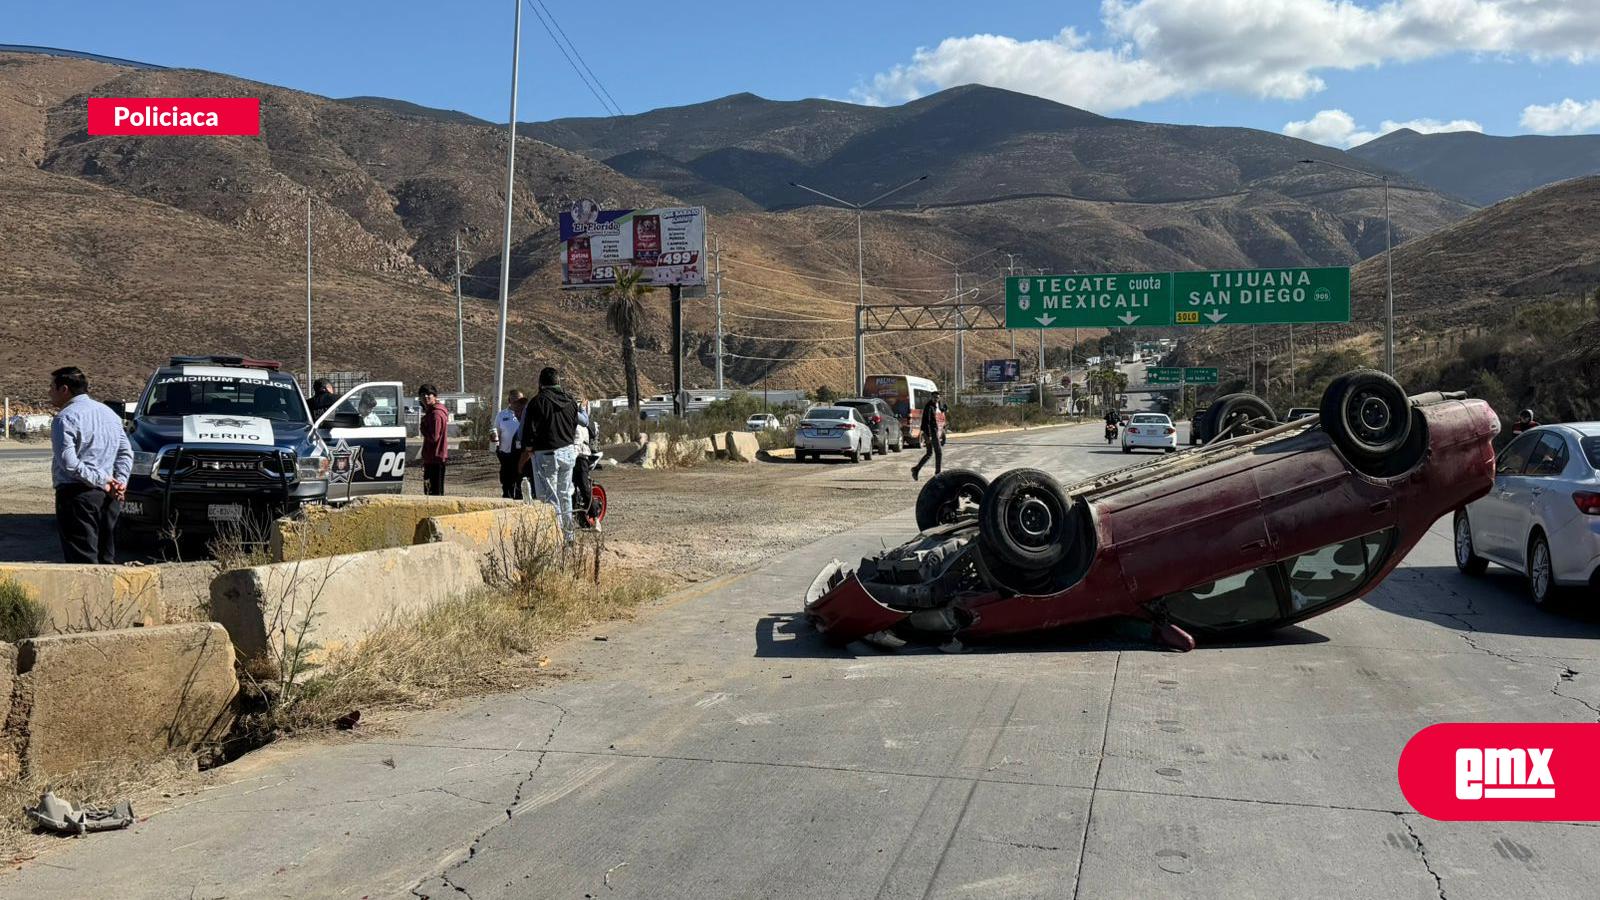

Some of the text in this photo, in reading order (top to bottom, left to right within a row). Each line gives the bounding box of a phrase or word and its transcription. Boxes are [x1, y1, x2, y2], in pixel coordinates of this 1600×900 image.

[588, 221, 620, 231] Florido
[1037, 277, 1117, 292] TECATE
[1129, 276, 1161, 290] cuota
[1210, 271, 1311, 288] TIJUANA
[1043, 293, 1149, 309] MEXICALI
[1189, 290, 1231, 306] SAN
[1240, 288, 1306, 304] DIEGO
[1177, 312, 1197, 321] SOLO
[198, 433, 260, 441] PERITO
[376, 452, 405, 477] PO
